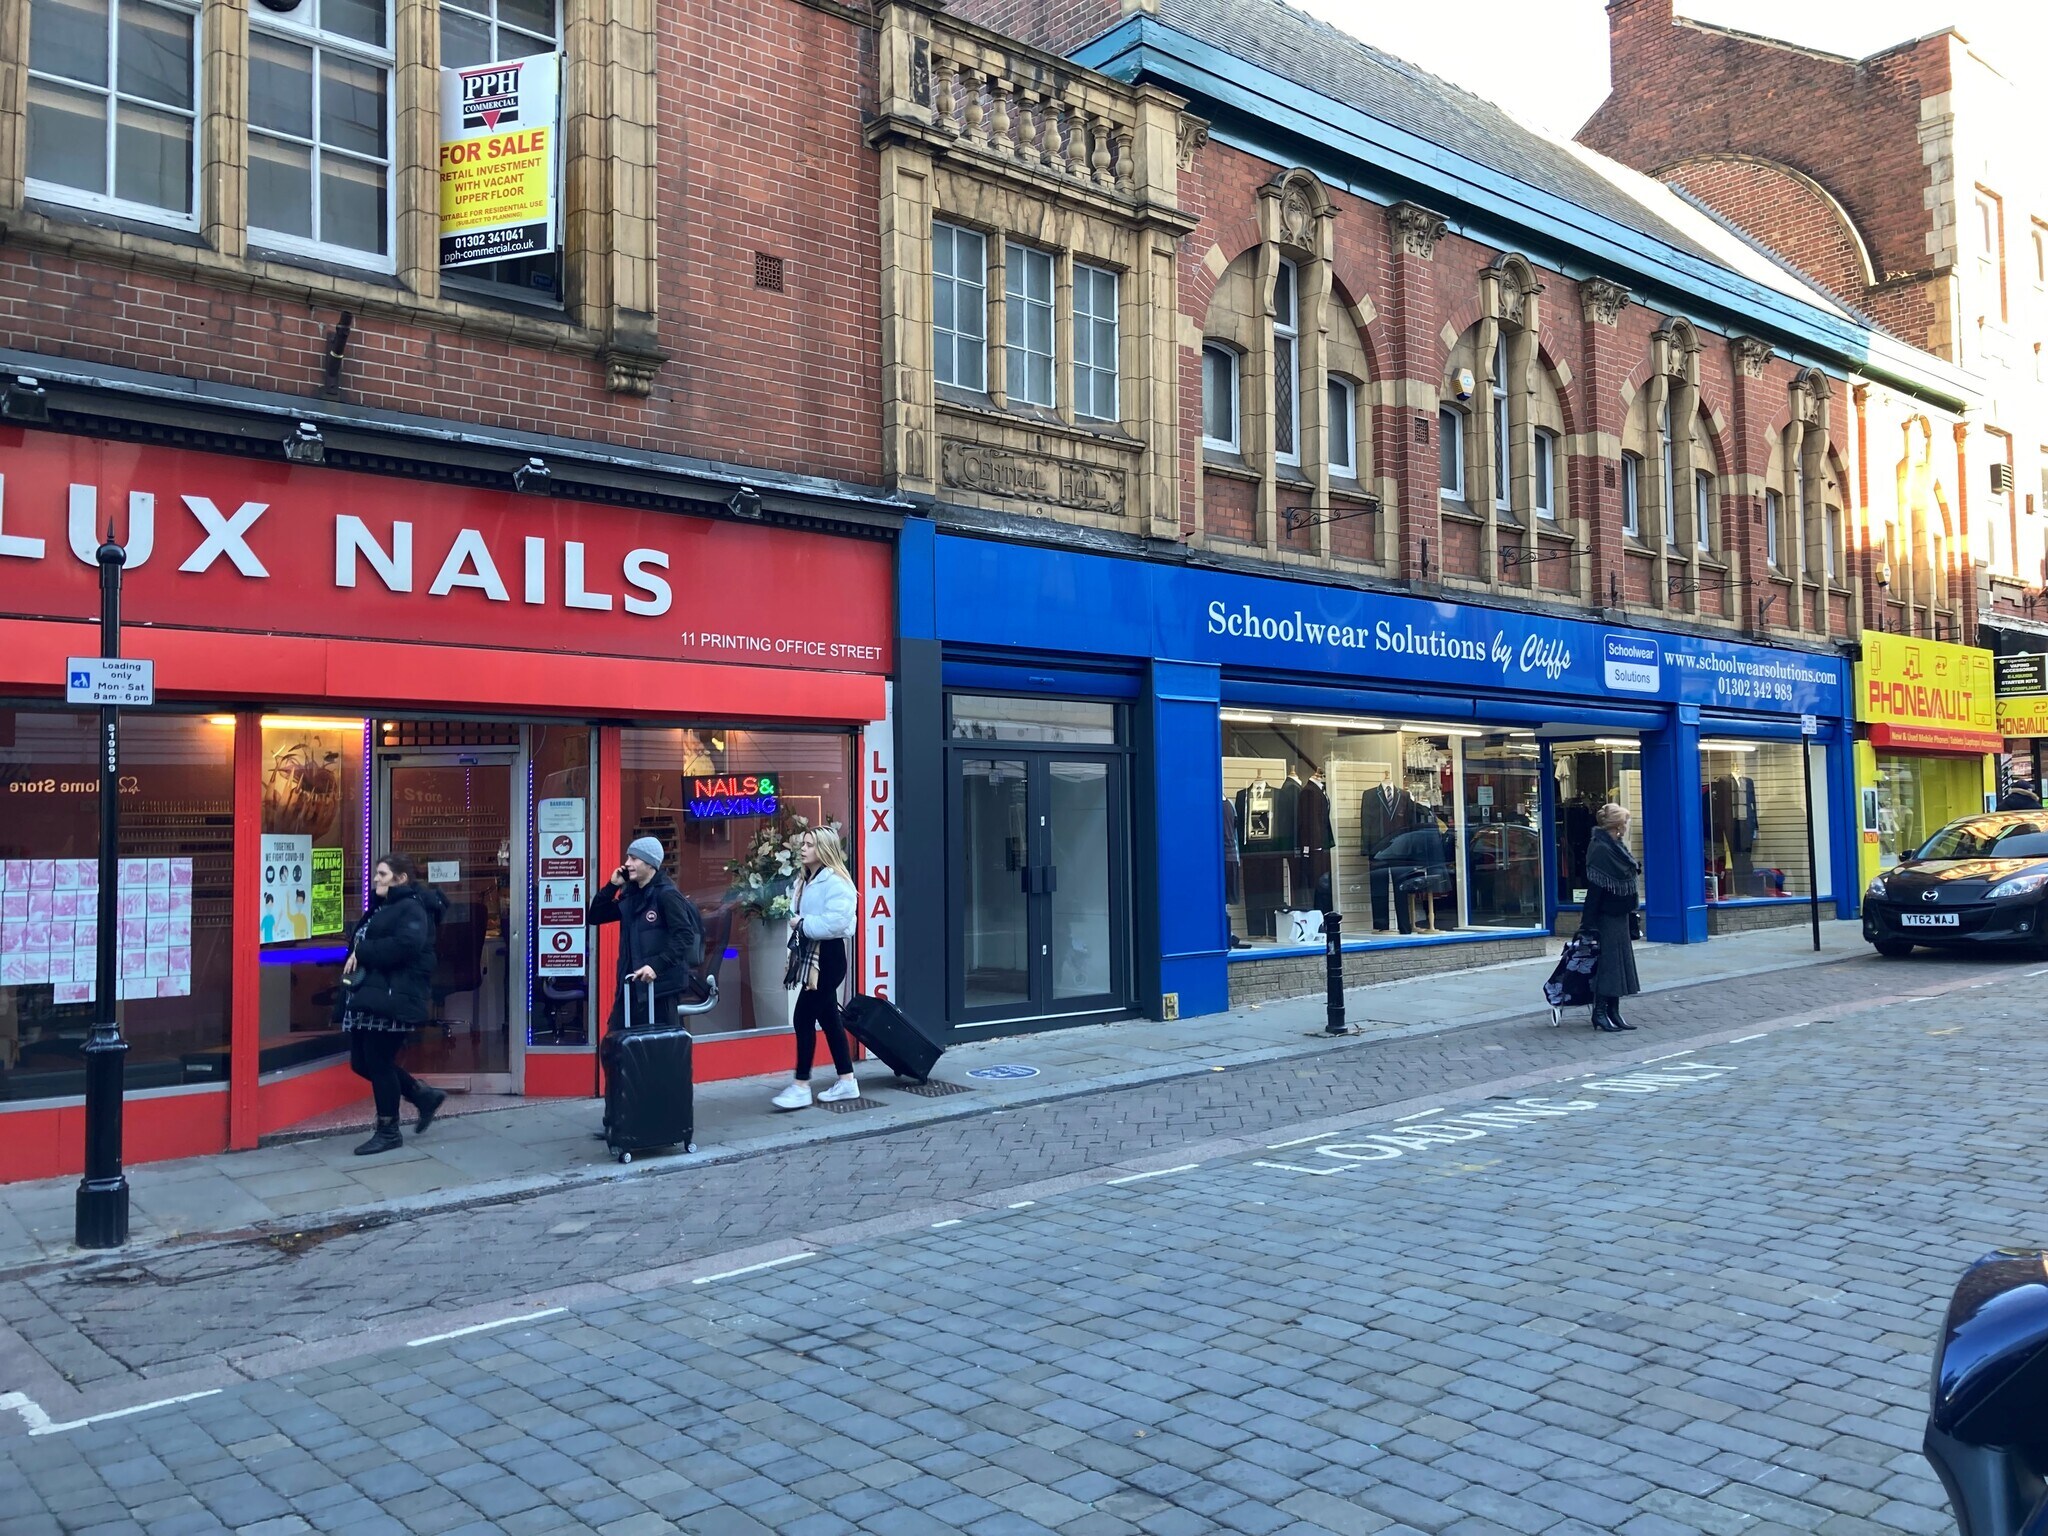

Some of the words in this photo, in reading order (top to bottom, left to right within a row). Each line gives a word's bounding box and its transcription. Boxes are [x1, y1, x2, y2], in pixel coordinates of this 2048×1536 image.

[465, 70, 517, 98] PPH
[464, 98, 516, 113] COMMERCIAL
[440, 143, 481, 167] FOR
[487, 131, 545, 159] SALE
[440, 169, 474, 183] RETAIL
[476, 157, 542, 177] INVESTMENT
[454, 180, 481, 193] WITH
[483, 173, 525, 189] VACANT
[455, 192, 489, 205] UPPER
[490, 186, 525, 200] FLOOR
[440, 208, 469, 222] UITABLE
[470, 207, 484, 217] FOR
[484, 203, 528, 215] RESIDENTIAL
[529, 199, 544, 208] USE
[455, 233, 486, 249] 01302
[487, 228, 524, 245] 341041
[444, 238, 535, 264] pph-commercial.co.uk
[963, 456, 1047, 491] CENTRAL
[1060, 471, 1107, 500] HALL
[336, 513, 673, 617] NAILS
[681, 631, 696, 646] 11
[701, 633, 772, 652] PRINTING
[775, 639, 827, 656] OFFICE
[830, 643, 883, 660] STREET
[1208, 600, 1368, 649] Schoolwear
[1376, 620, 1486, 661] Solutions
[1491, 630, 1513, 674] by
[1519, 633, 1573, 680] Cliffs
[1608, 643, 1654, 660] Schoolwear
[102, 661, 142, 672] Loading
[111, 671, 133, 681] only
[1614, 669, 1651, 684] Solutions
[1664, 650, 1838, 686] www.schoolwearsolutions.com
[98, 682, 119, 691] Mon
[128, 683, 145, 692] Sat
[1718, 676, 1751, 697] 01302
[1753, 681, 1772, 699] 342
[1774, 683, 1793, 701] 983
[1869, 680, 1972, 721] PHONEVAULT
[1996, 717, 2048, 735] HONEVAUL
[107, 723, 117, 773] S19699
[871, 750, 890, 832] LUX
[689, 795, 777, 818] WAXING
[274, 842, 295, 851] TOGETHER
[1865, 832, 1878, 843] NEW
[1906, 914, 1932, 924] YT62
[1935, 914, 1955, 924] WAJ
[1252, 1097, 1599, 1176] LOADING
[1581, 1061, 1738, 1093] ONLY
